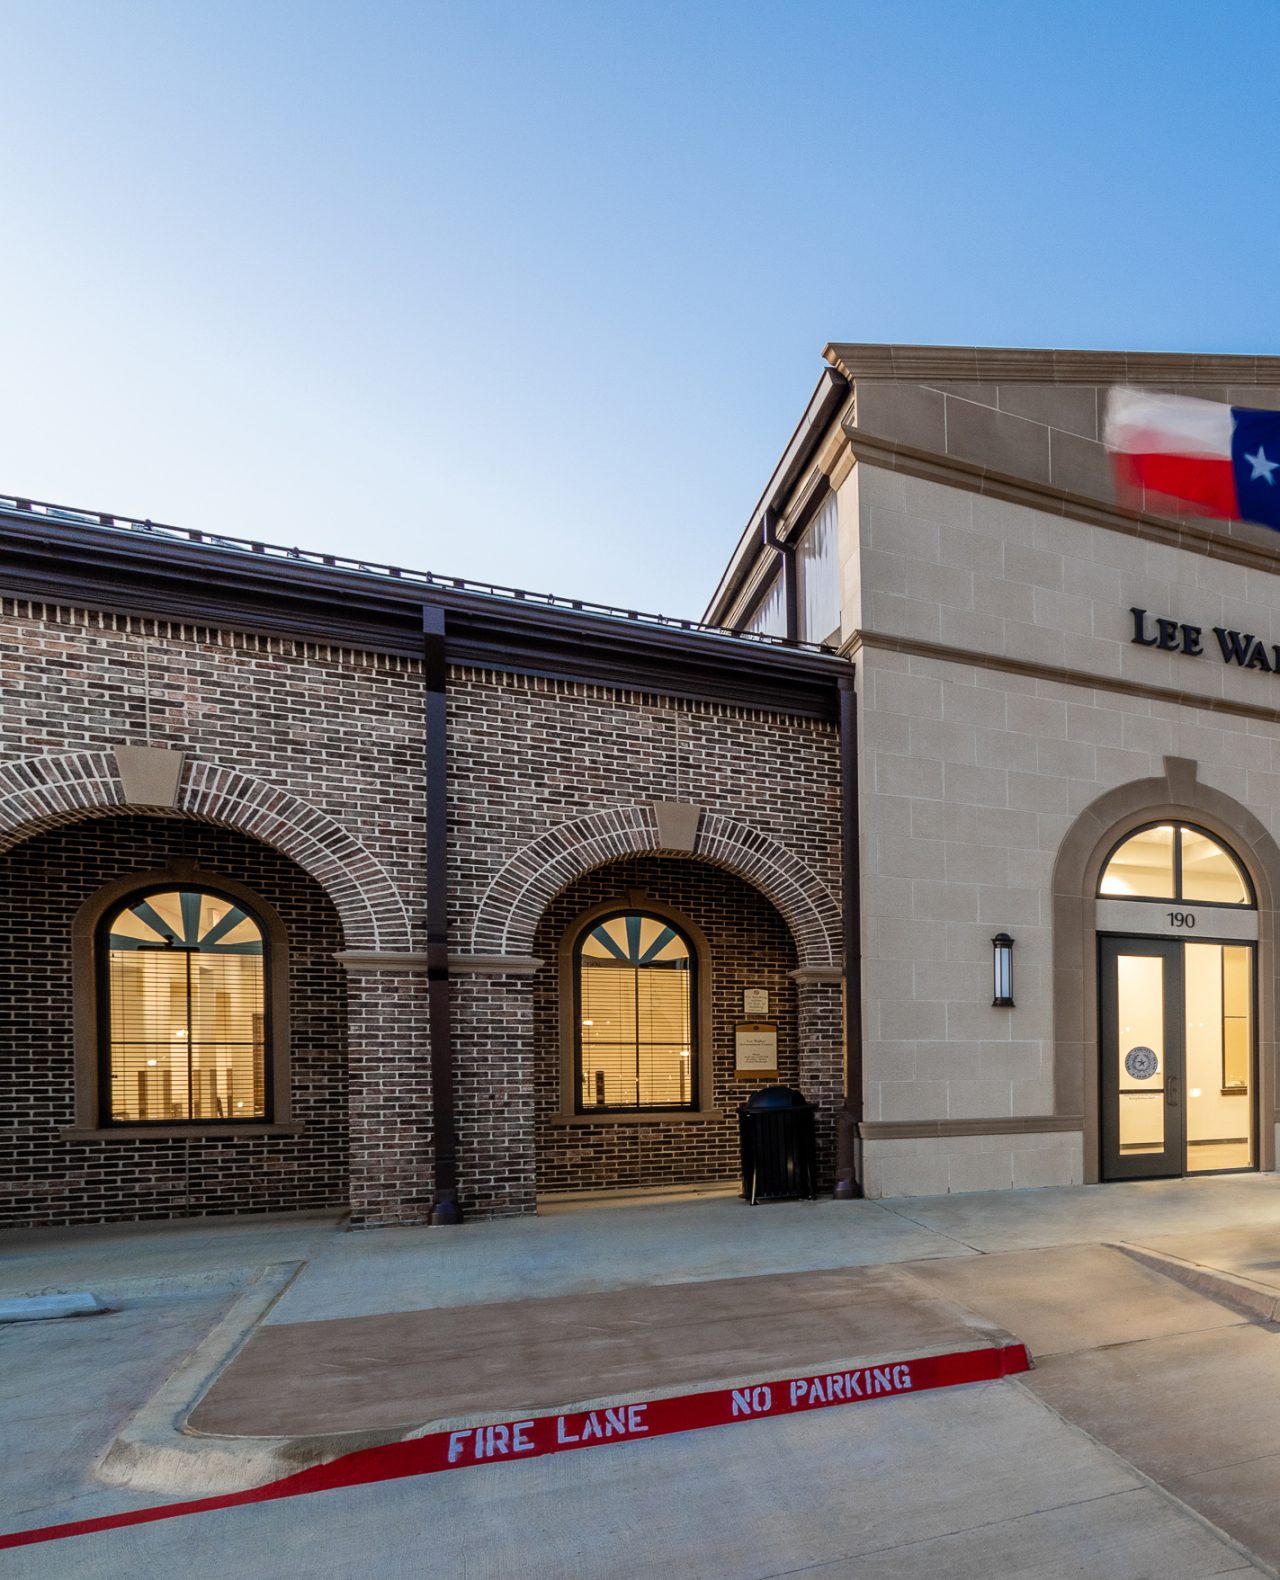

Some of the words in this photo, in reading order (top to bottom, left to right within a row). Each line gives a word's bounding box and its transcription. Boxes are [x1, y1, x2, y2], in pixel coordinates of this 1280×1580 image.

[1129, 607, 1204, 657] LEE
[1166, 912, 1196, 929] 190
[730, 1384, 773, 1416] NO
[789, 1365, 912, 1407] PARKING
[447, 1421, 535, 1463] FIRE
[557, 1404, 649, 1445] LANE
